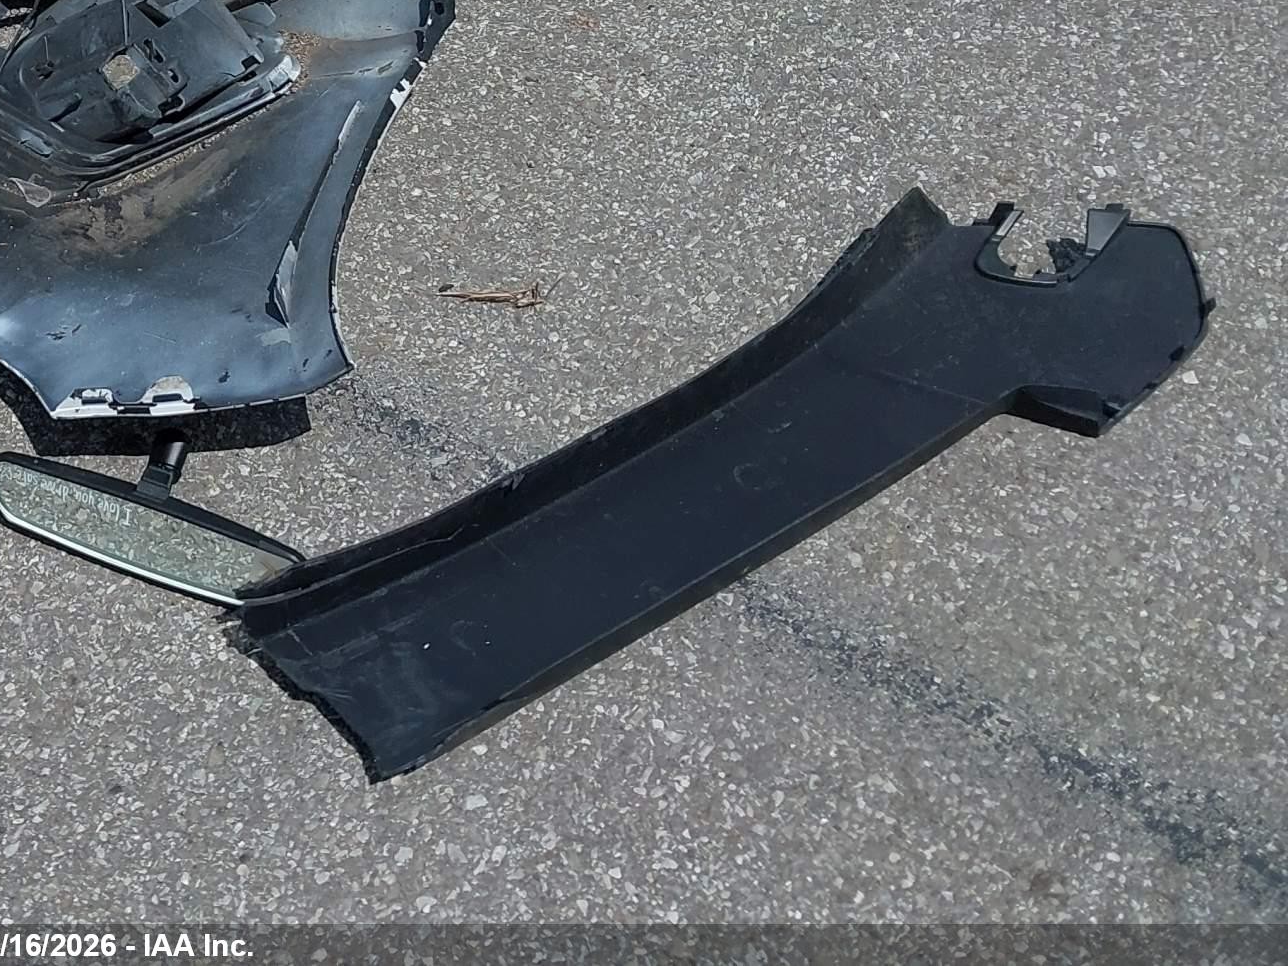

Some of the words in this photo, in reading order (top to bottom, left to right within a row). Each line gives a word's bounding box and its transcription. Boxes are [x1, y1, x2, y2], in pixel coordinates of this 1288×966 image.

[15, 469, 38, 486] safe
[40, 480, 69, 502] drive
[98, 497, 120, 521] love
[122, 506, 133, 527] I
